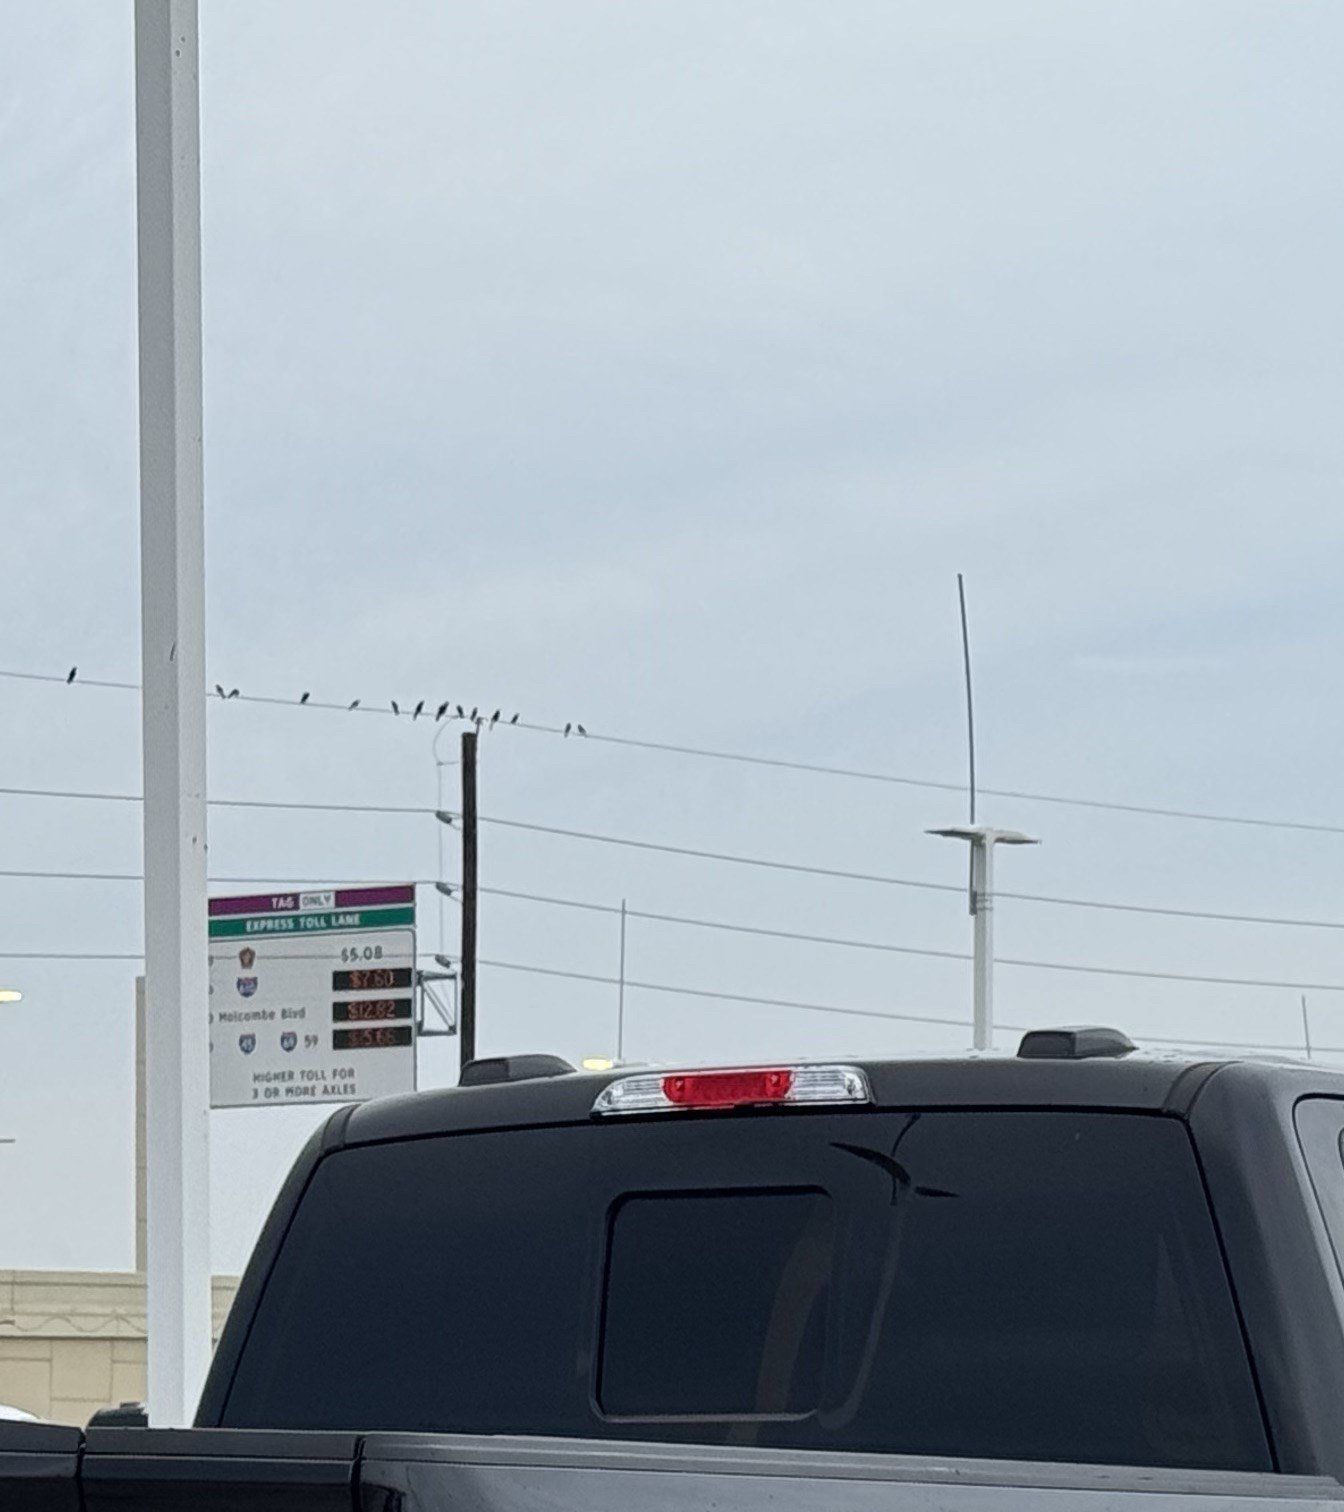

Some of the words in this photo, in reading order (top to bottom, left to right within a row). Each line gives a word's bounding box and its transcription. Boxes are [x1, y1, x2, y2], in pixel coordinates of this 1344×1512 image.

[272, 897, 296, 910] TAG
[301, 894, 332, 907] ONLY
[245, 917, 295, 932] EXPRESS
[299, 916, 327, 928] TOLL
[332, 914, 361, 926] LANE
[341, 946, 383, 963] $5.08
[281, 1006, 306, 1020] Blvd
[304, 1035, 319, 1048] 59
[253, 1070, 295, 1083] HIGHER
[300, 1069, 327, 1081] TOLL
[333, 1067, 355, 1080] FOR
[264, 1087, 280, 1098] OR
[285, 1085, 316, 1097] MORE
[322, 1083, 356, 1095] AXLES
